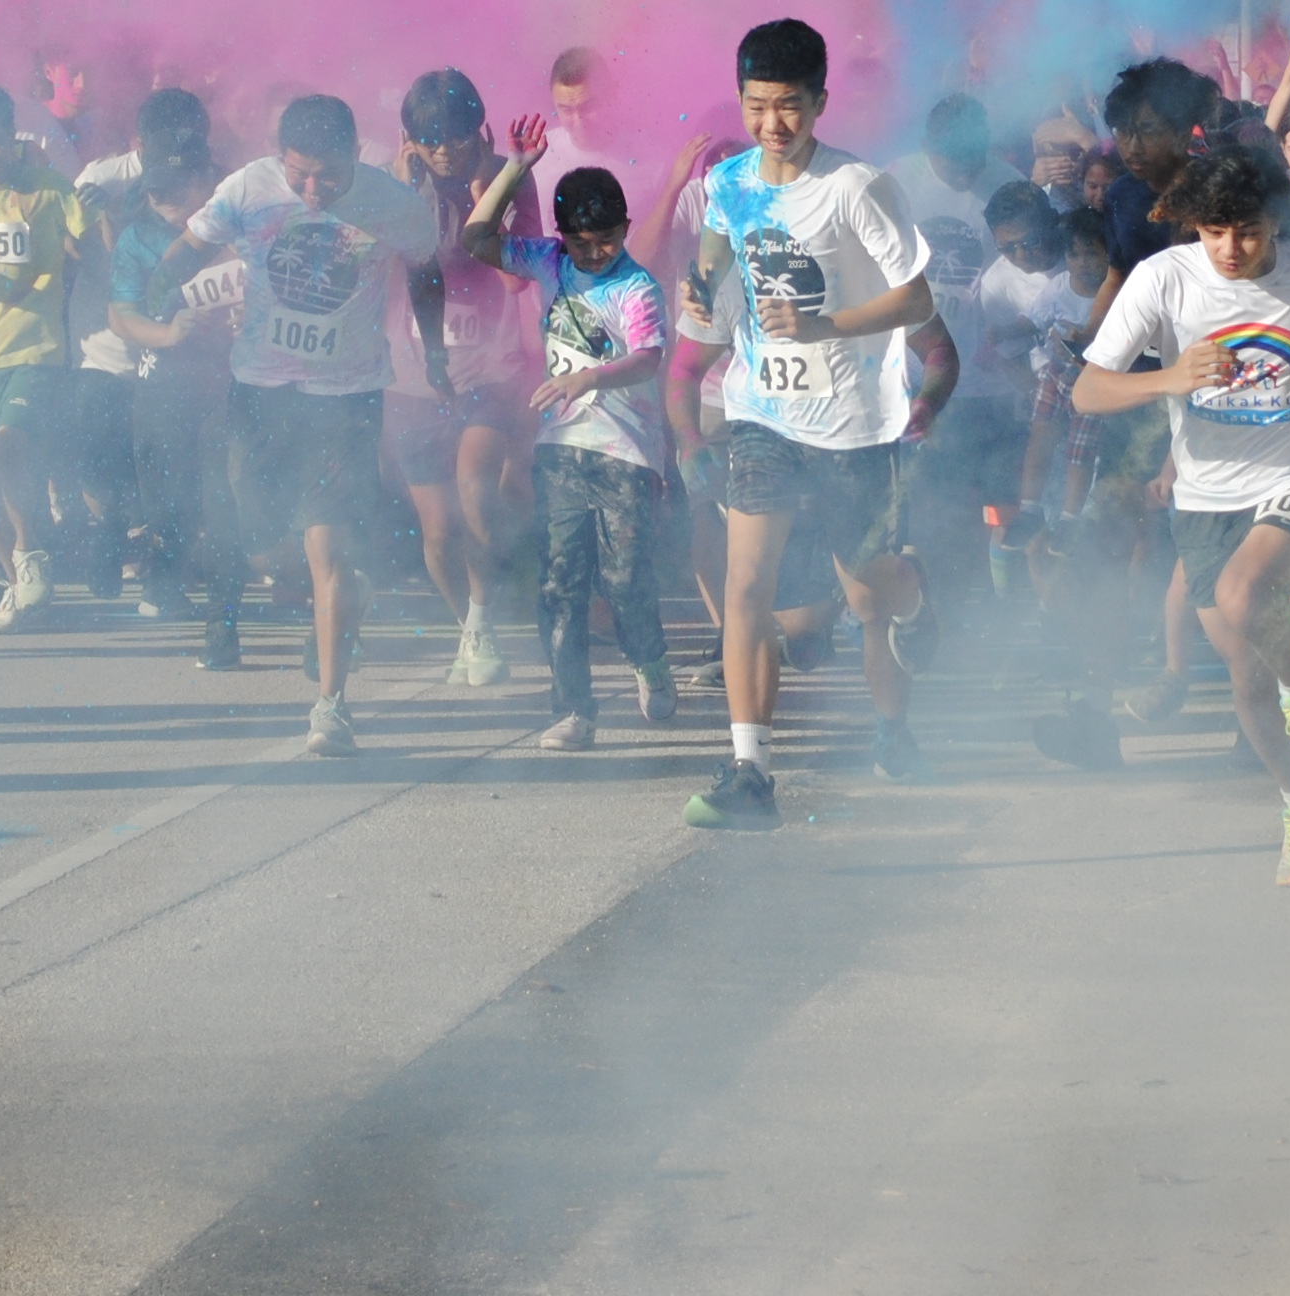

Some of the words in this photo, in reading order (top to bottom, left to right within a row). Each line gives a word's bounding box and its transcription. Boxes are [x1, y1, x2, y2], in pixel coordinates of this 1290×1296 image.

[788, 260, 809, 269] 2022
[271, 316, 337, 357] 1064
[759, 356, 810, 391] 432
